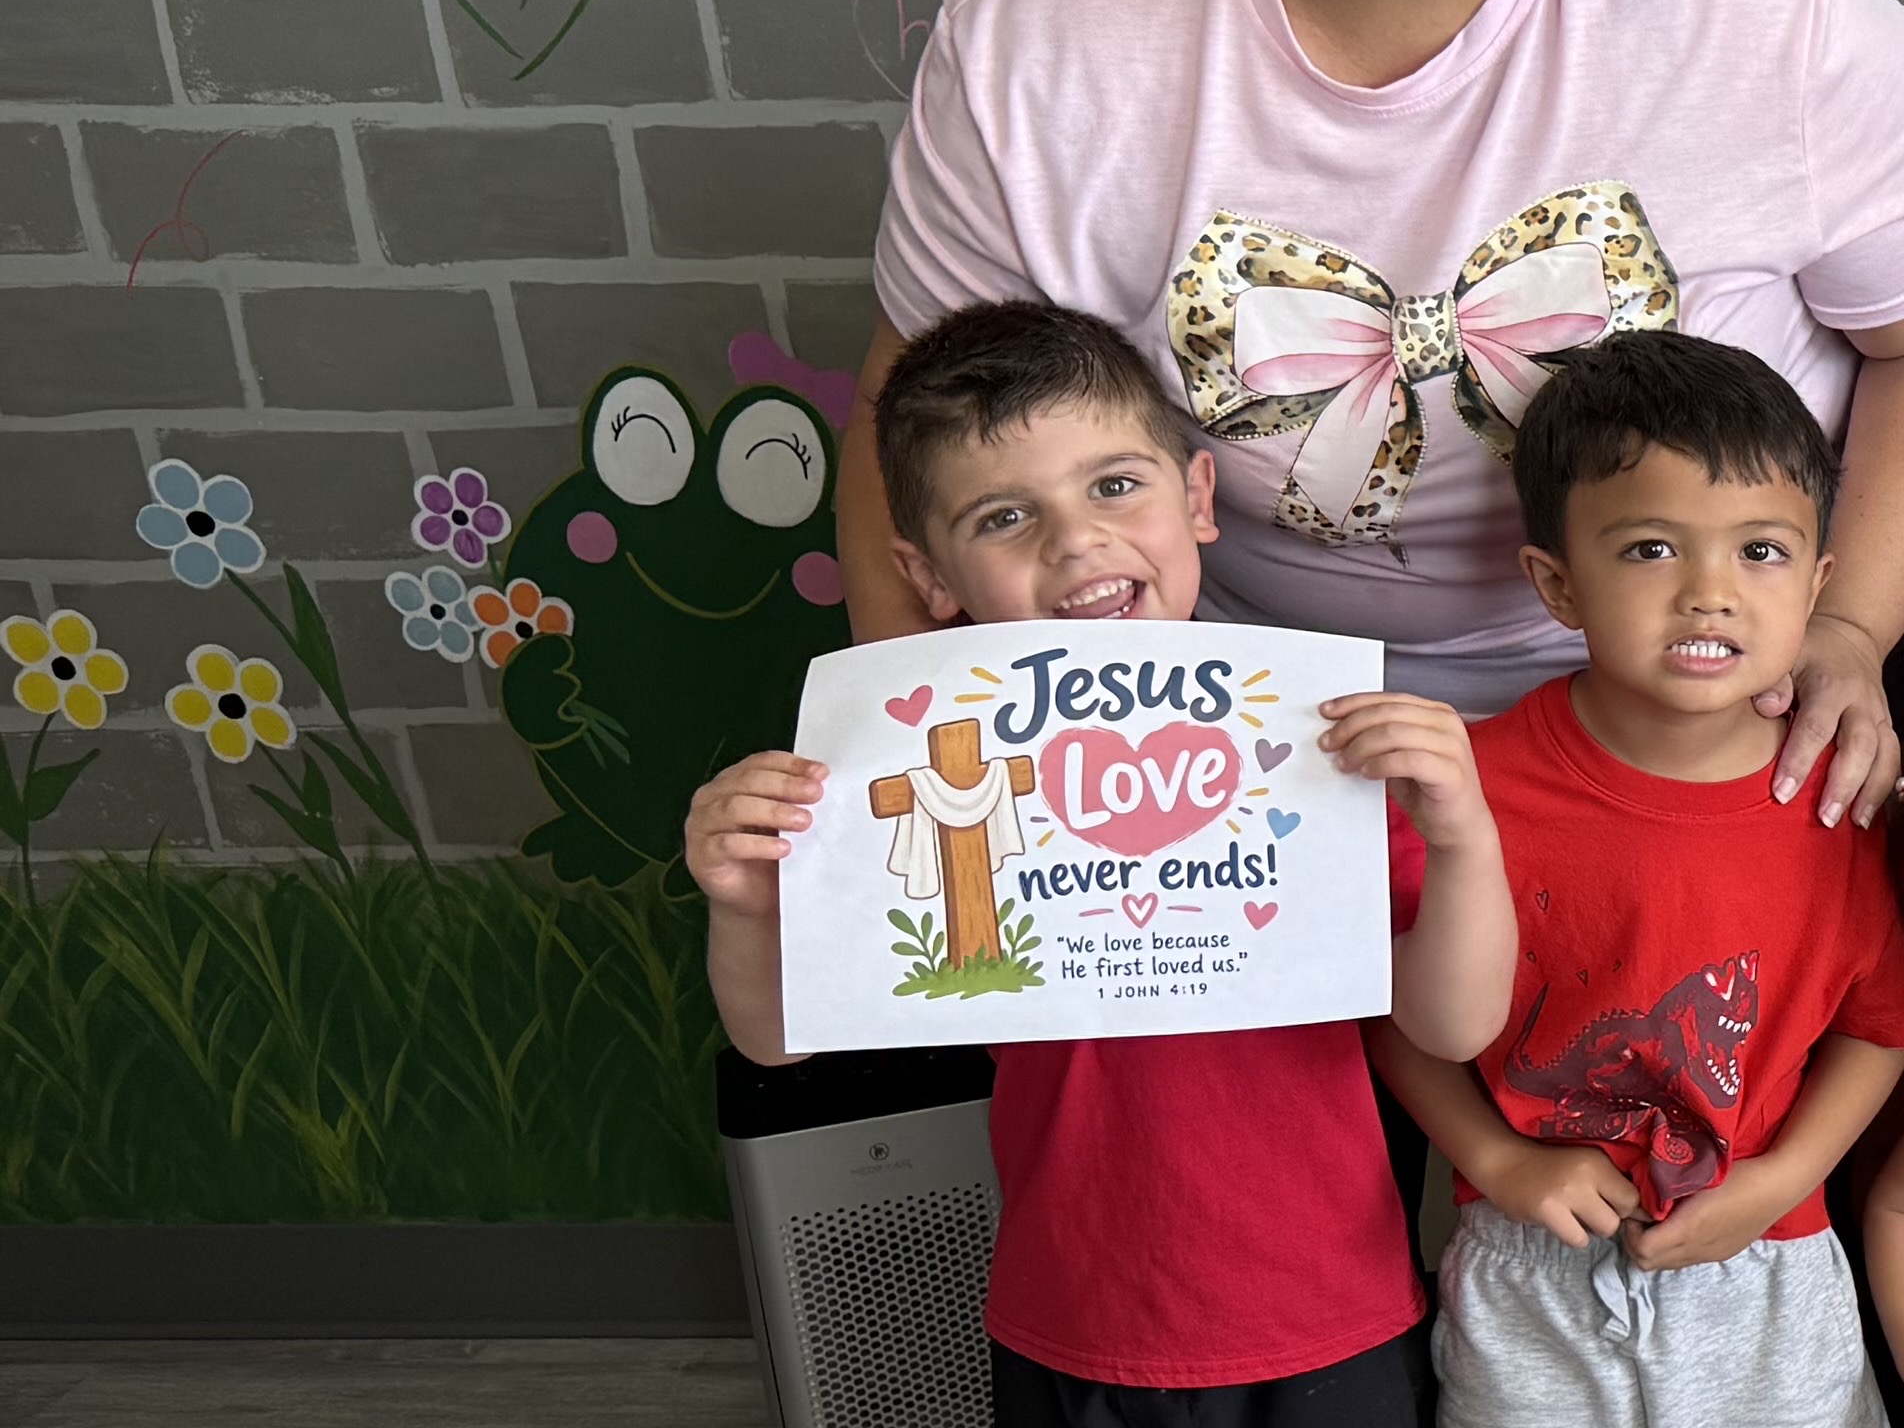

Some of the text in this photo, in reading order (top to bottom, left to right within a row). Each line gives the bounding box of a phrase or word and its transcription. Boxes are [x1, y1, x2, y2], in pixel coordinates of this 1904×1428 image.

[994, 648, 1234, 744] Jesus
[1064, 741, 1229, 830] Love
[1017, 841, 1279, 903] never ends!
[1103, 931, 1143, 951] love
[1151, 930, 1231, 950] because
[1061, 959, 1087, 979] He
[1095, 956, 1144, 978] first
[1151, 954, 1204, 976] loved
[1114, 985, 1161, 999] JOHN
[1169, 982, 1208, 997] 4:19
